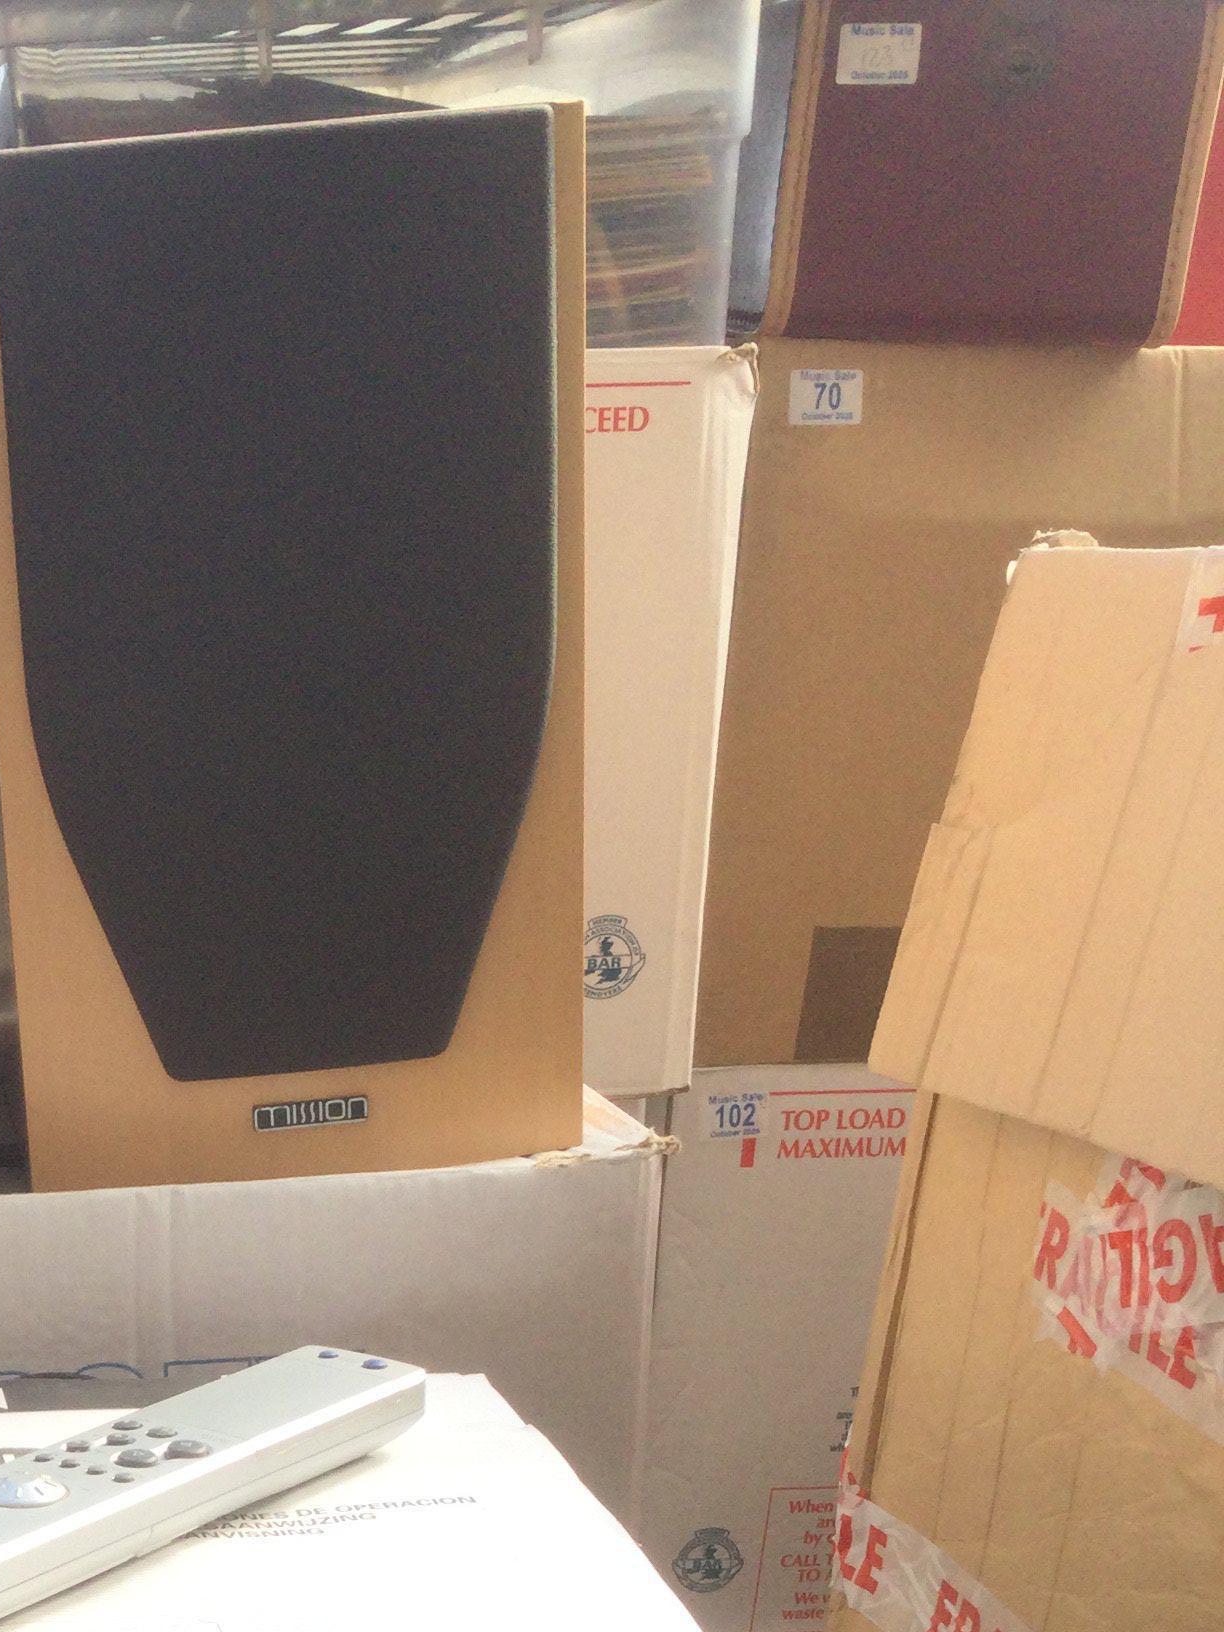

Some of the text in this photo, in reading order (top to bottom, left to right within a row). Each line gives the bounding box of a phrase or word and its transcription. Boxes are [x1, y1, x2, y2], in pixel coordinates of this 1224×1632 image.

[813, 382, 842, 410] 70
[587, 957, 622, 970] BAR
[715, 1103, 756, 1128] 102
[781, 1107, 907, 1131] TOP LOAD
[777, 1136, 907, 1159] MAXIMUM
[335, 1495, 477, 1514] OPERACION
[789, 1500, 834, 1514] When
[803, 1532, 822, 1548] by
[780, 1553, 820, 1568] CALL
[797, 1568, 821, 1583] TO
[782, 1607, 824, 1620] waste
